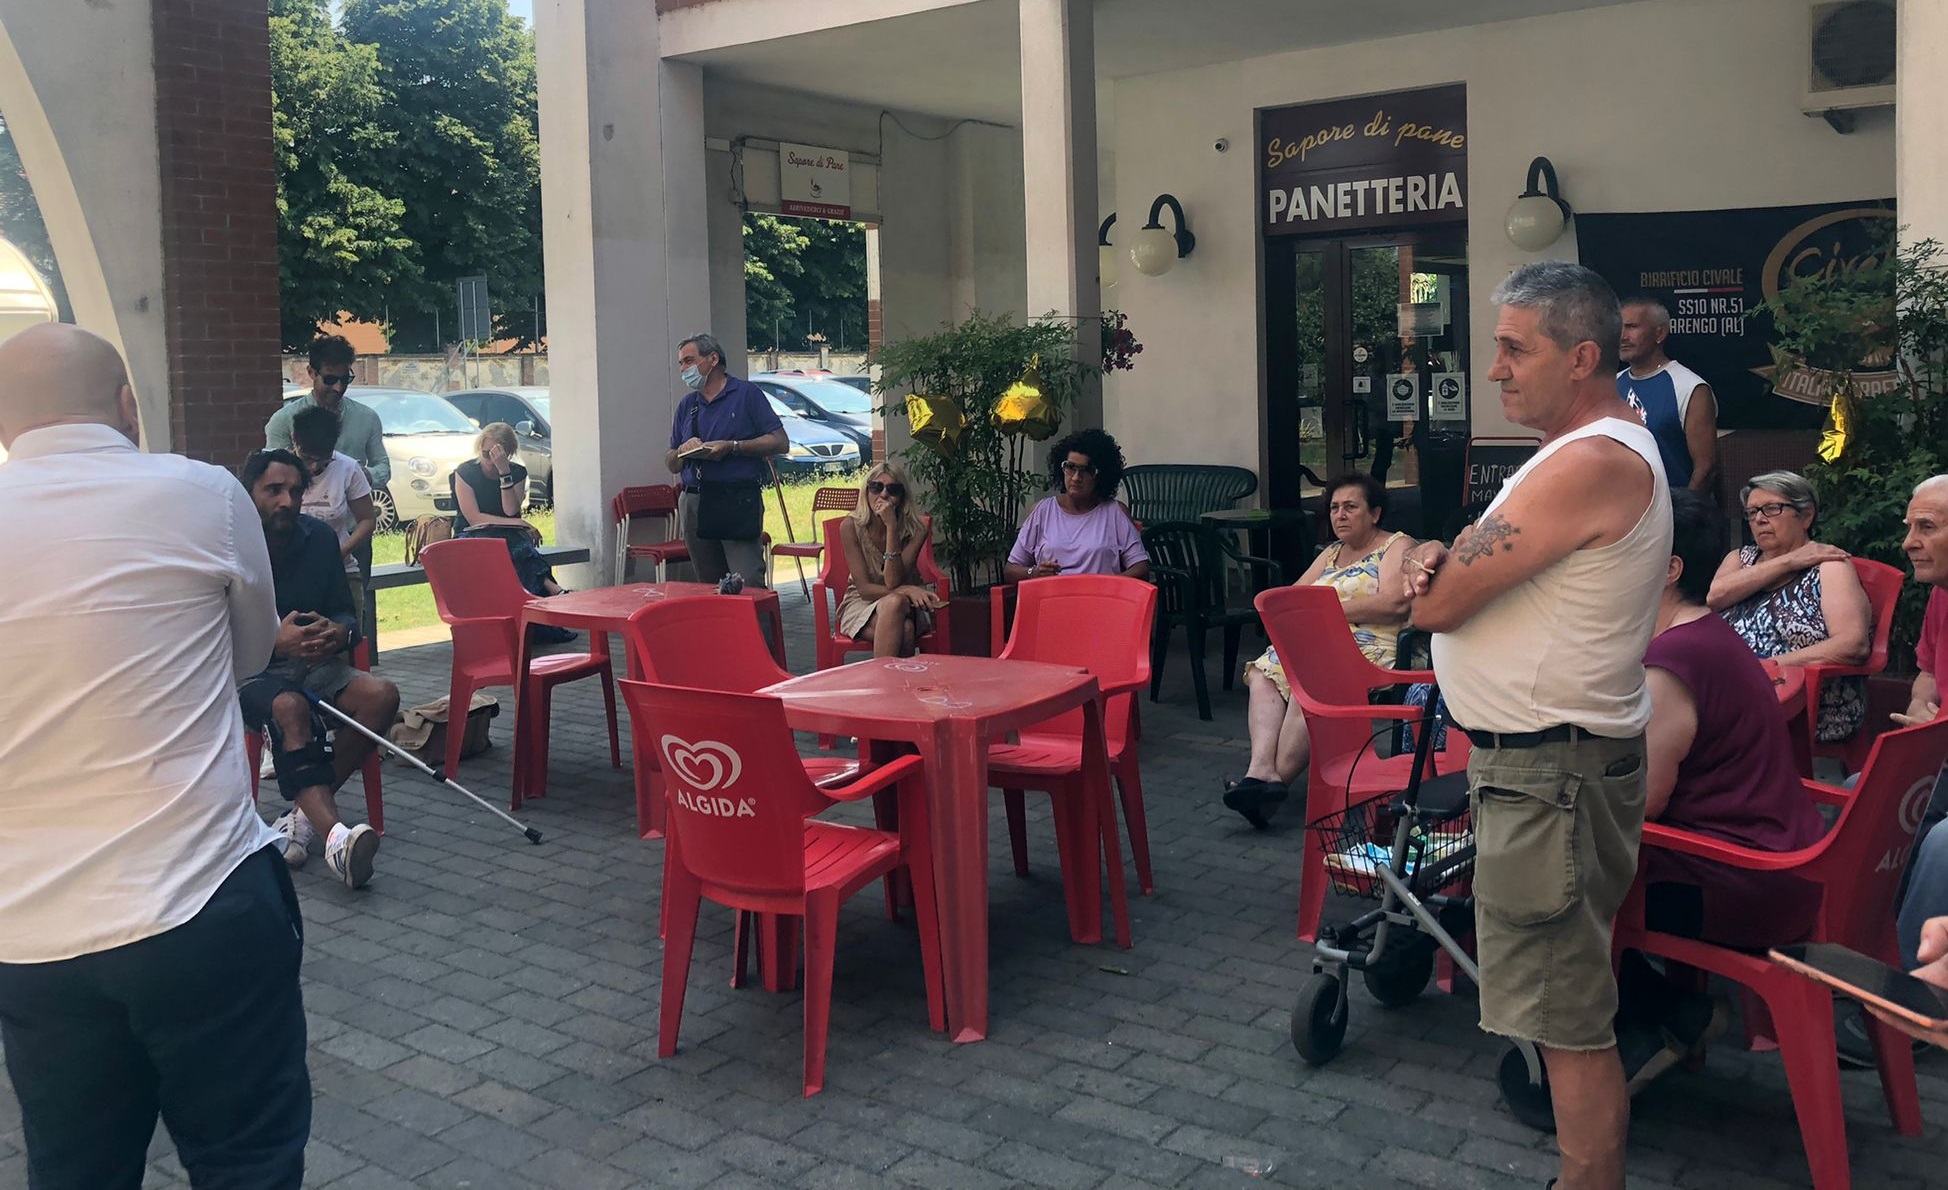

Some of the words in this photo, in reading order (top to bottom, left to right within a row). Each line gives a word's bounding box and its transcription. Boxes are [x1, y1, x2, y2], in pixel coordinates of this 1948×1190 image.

[1267, 122, 1356, 168] Sapore
[1363, 110, 1392, 137] di
[1394, 121, 1465, 149] pane
[1269, 171, 1464, 224] PANETTERIA
[1640, 269, 1700, 288] BIRRIFICIO
[1702, 268, 1744, 286] CIVALE
[1678, 298, 1707, 315] SS10
[1710, 297, 1744, 314] NR.51
[1669, 317, 1717, 334] ARENGO
[1469, 464, 1522, 485] ENTRA
[1471, 489, 1498, 502] MA
